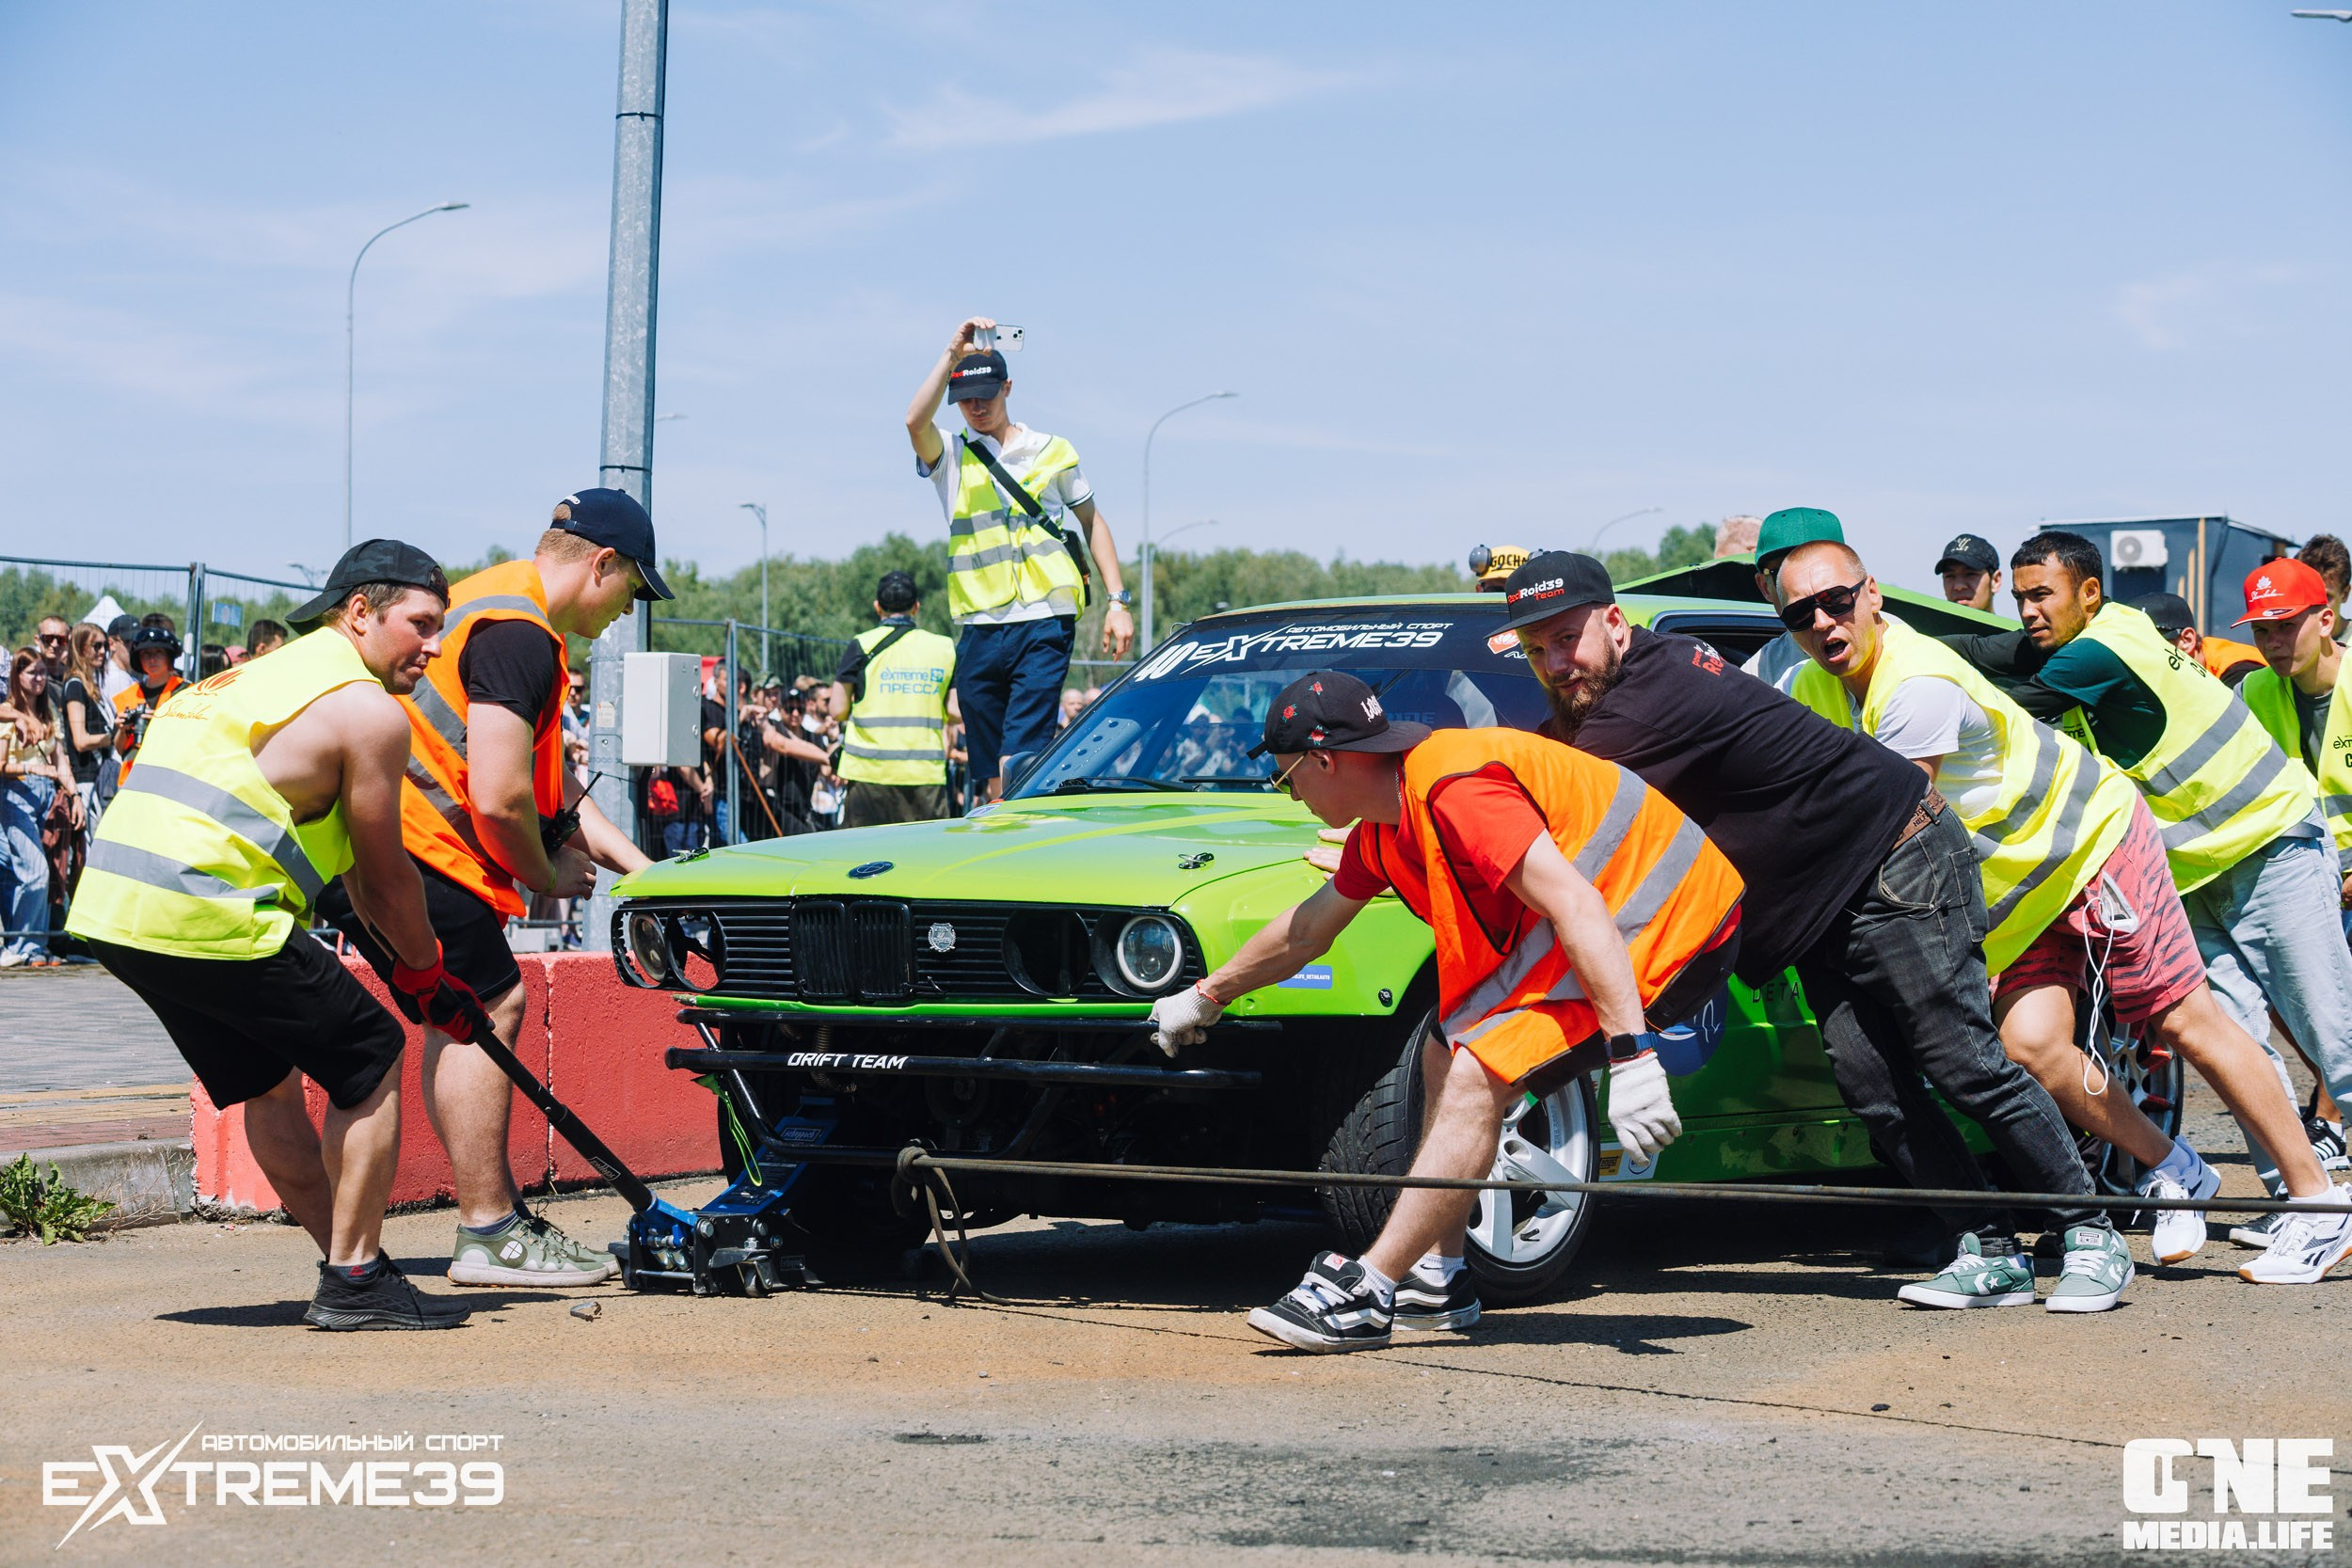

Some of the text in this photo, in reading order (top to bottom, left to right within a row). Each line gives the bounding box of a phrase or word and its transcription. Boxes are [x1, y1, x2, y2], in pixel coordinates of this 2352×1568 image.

[1286, 622, 1403, 634] АВТОМОБИЛЬНЫЙ
[787, 1053, 909, 1069] DRIFT TEAM
